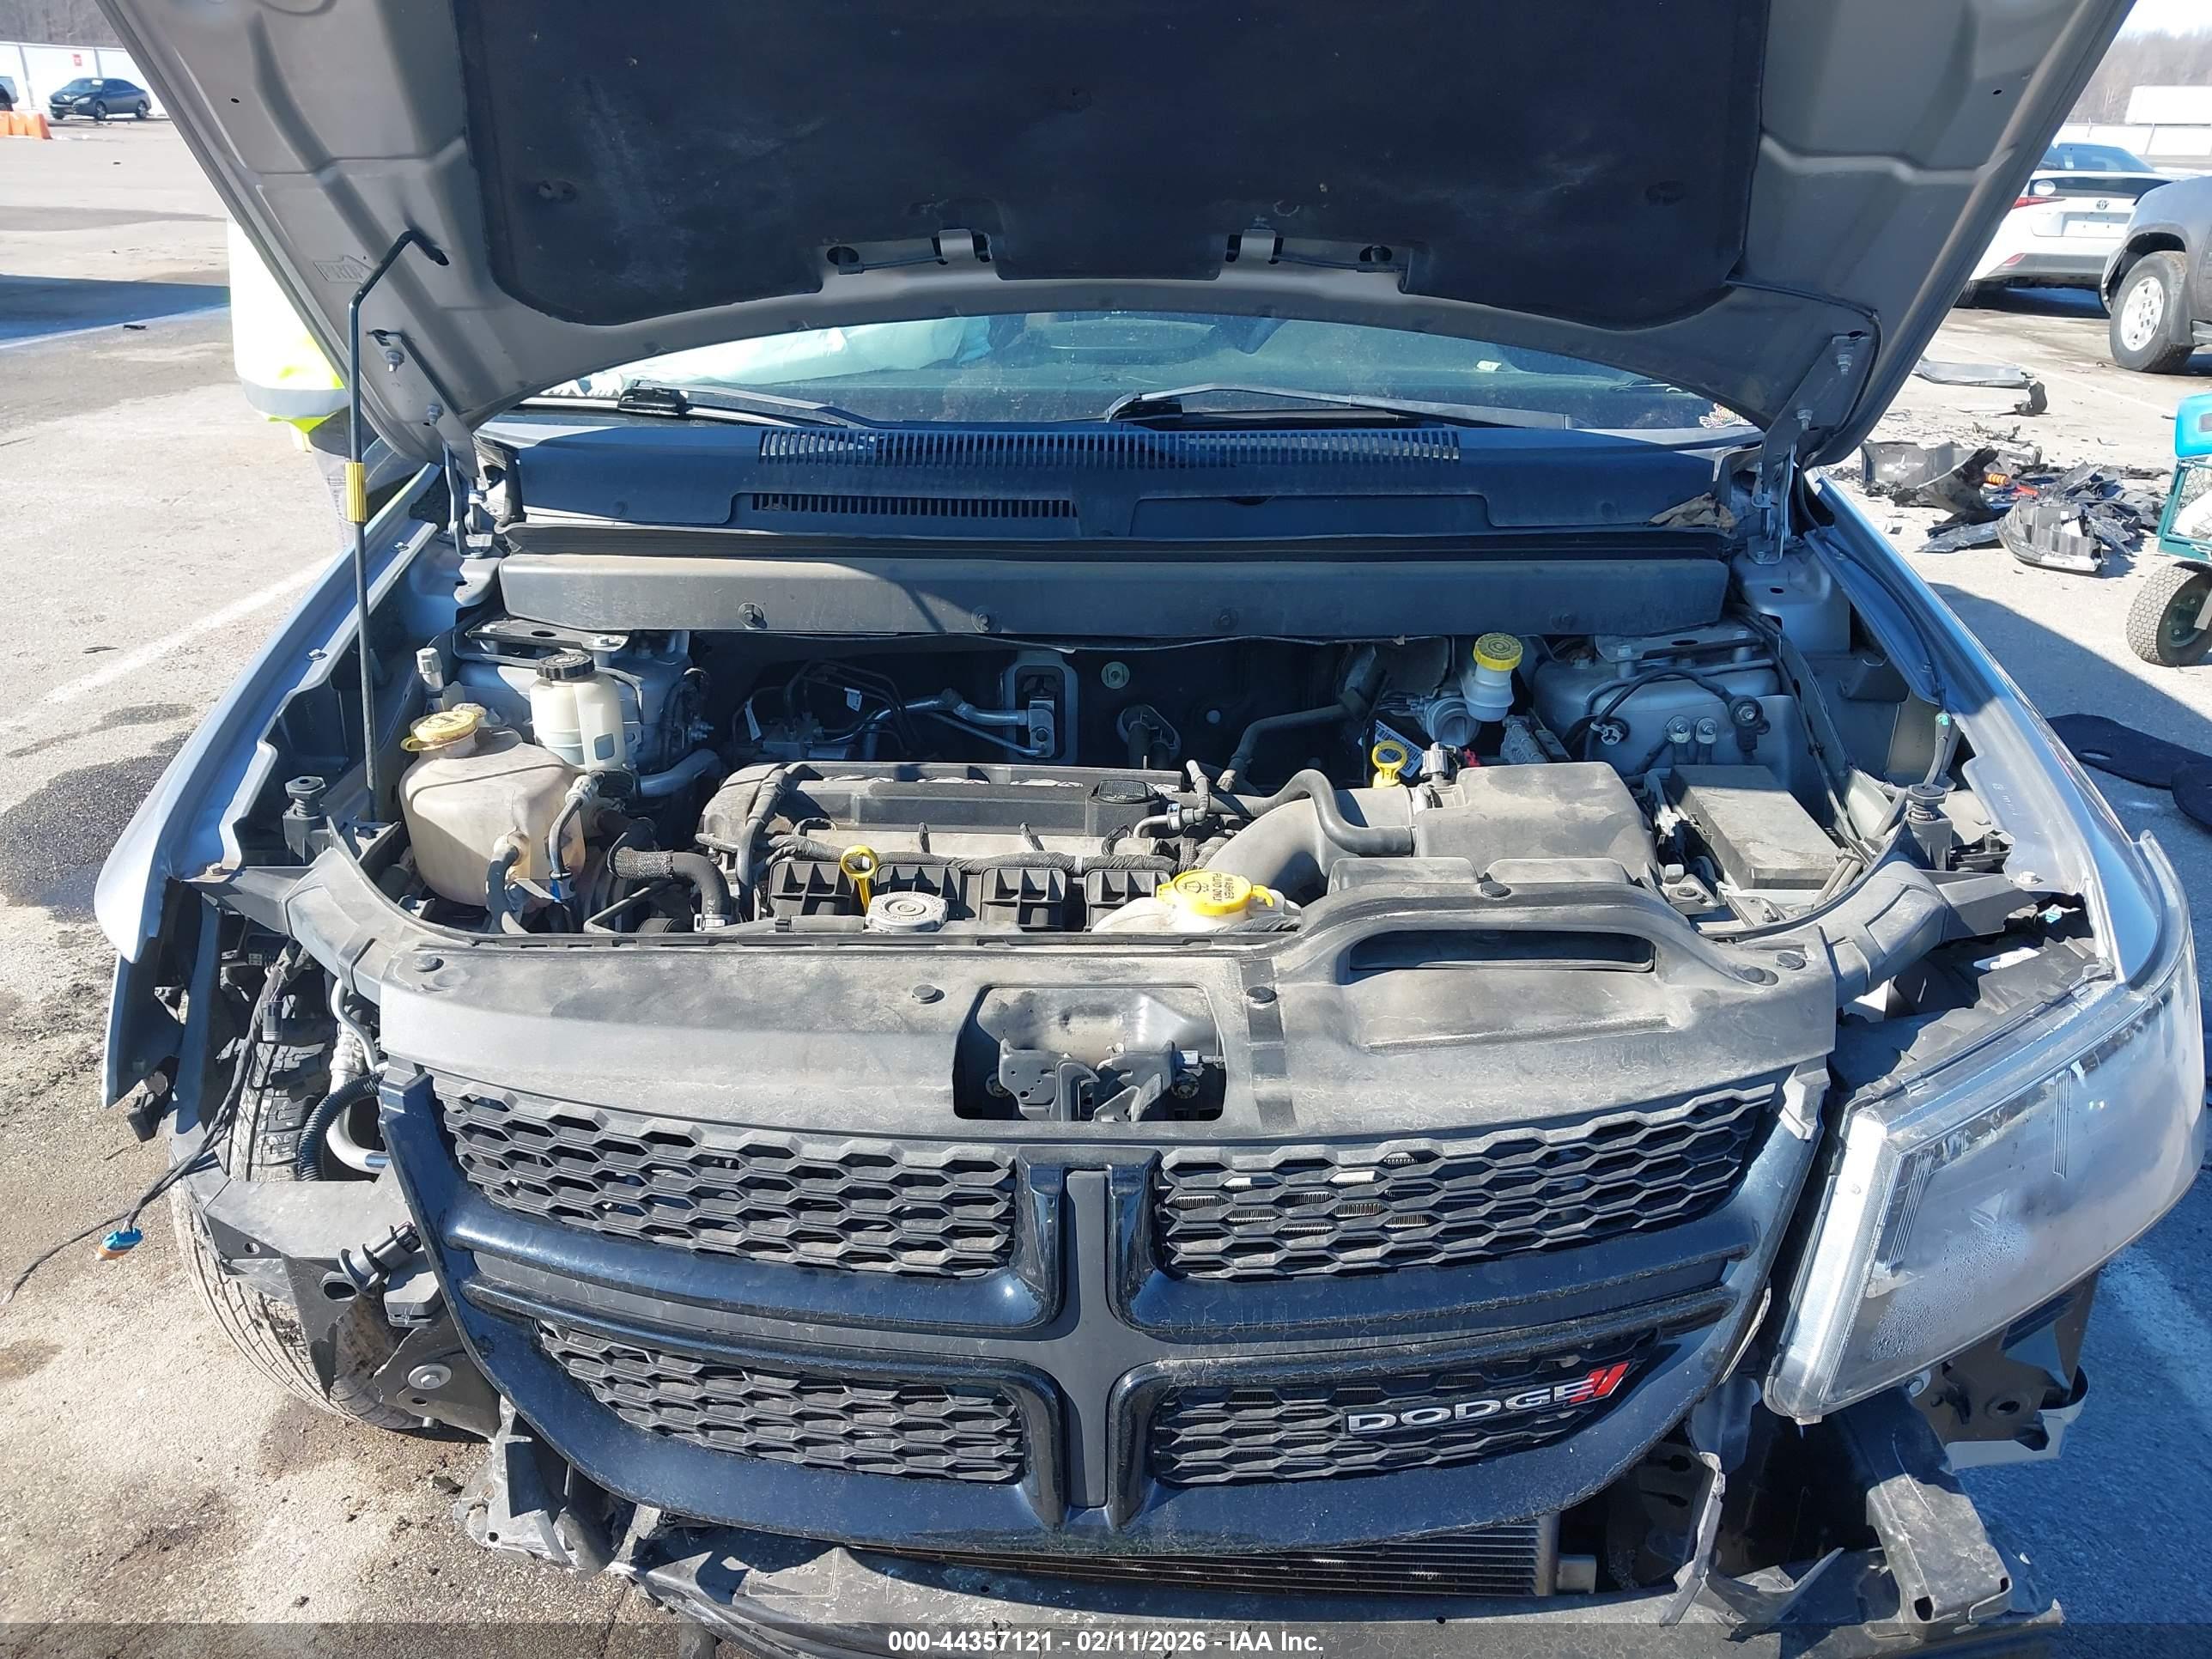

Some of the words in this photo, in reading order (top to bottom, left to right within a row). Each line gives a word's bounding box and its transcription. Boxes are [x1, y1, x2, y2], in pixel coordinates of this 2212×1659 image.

[1212, 872, 1222, 888] FLUID
[1224, 877, 1234, 899] WASHER
[1212, 888, 1222, 902] ONLY
[1347, 1377, 1595, 1431] DODGE
